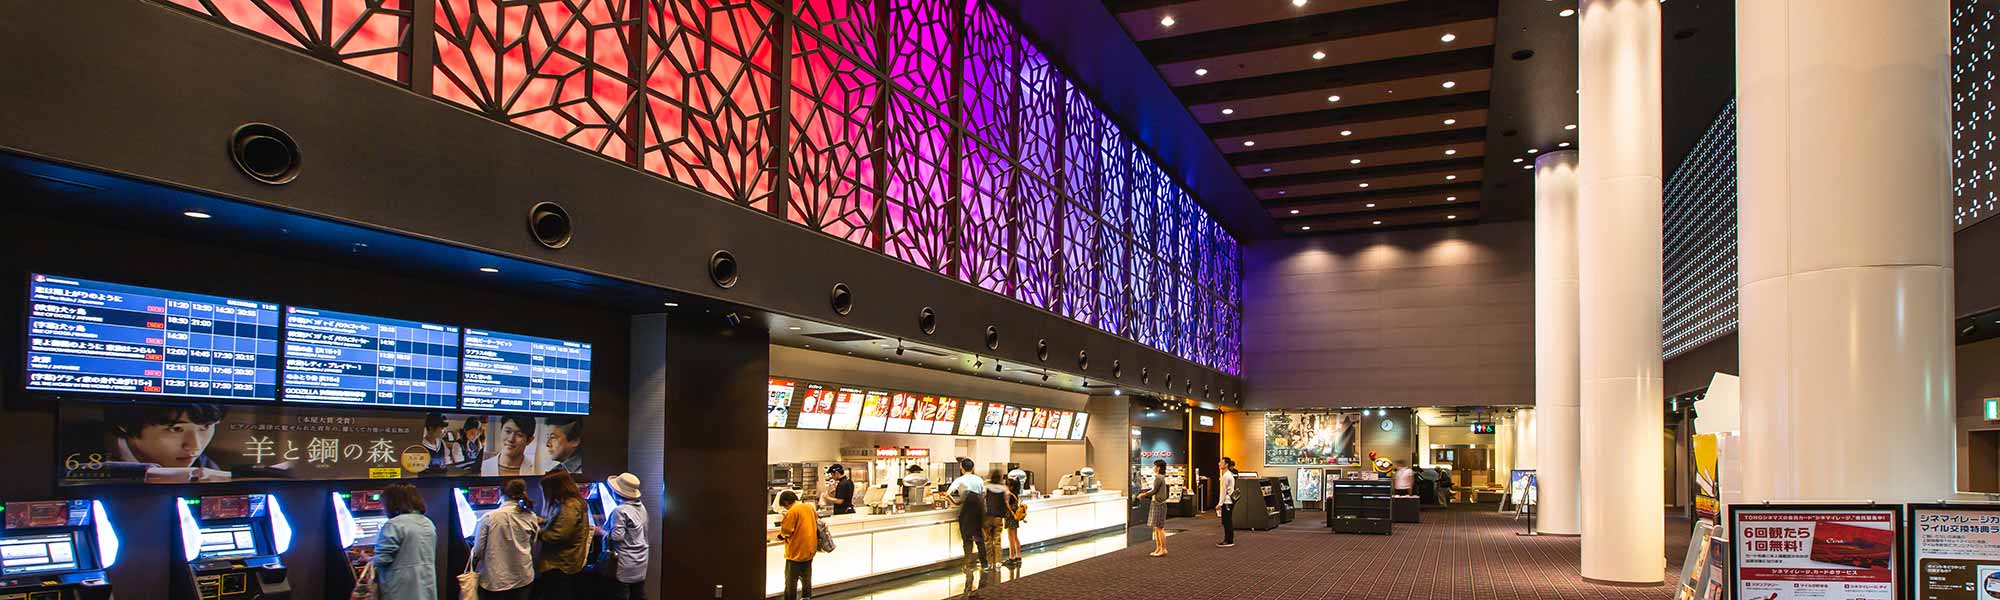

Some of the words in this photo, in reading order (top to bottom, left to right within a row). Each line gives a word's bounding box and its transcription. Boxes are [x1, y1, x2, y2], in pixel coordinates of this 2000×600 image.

[242, 436, 398, 463] 羊と鋼の森
[1744, 527, 1810, 539] 6回観たら
[1745, 540, 1803, 552] 1回無料!
